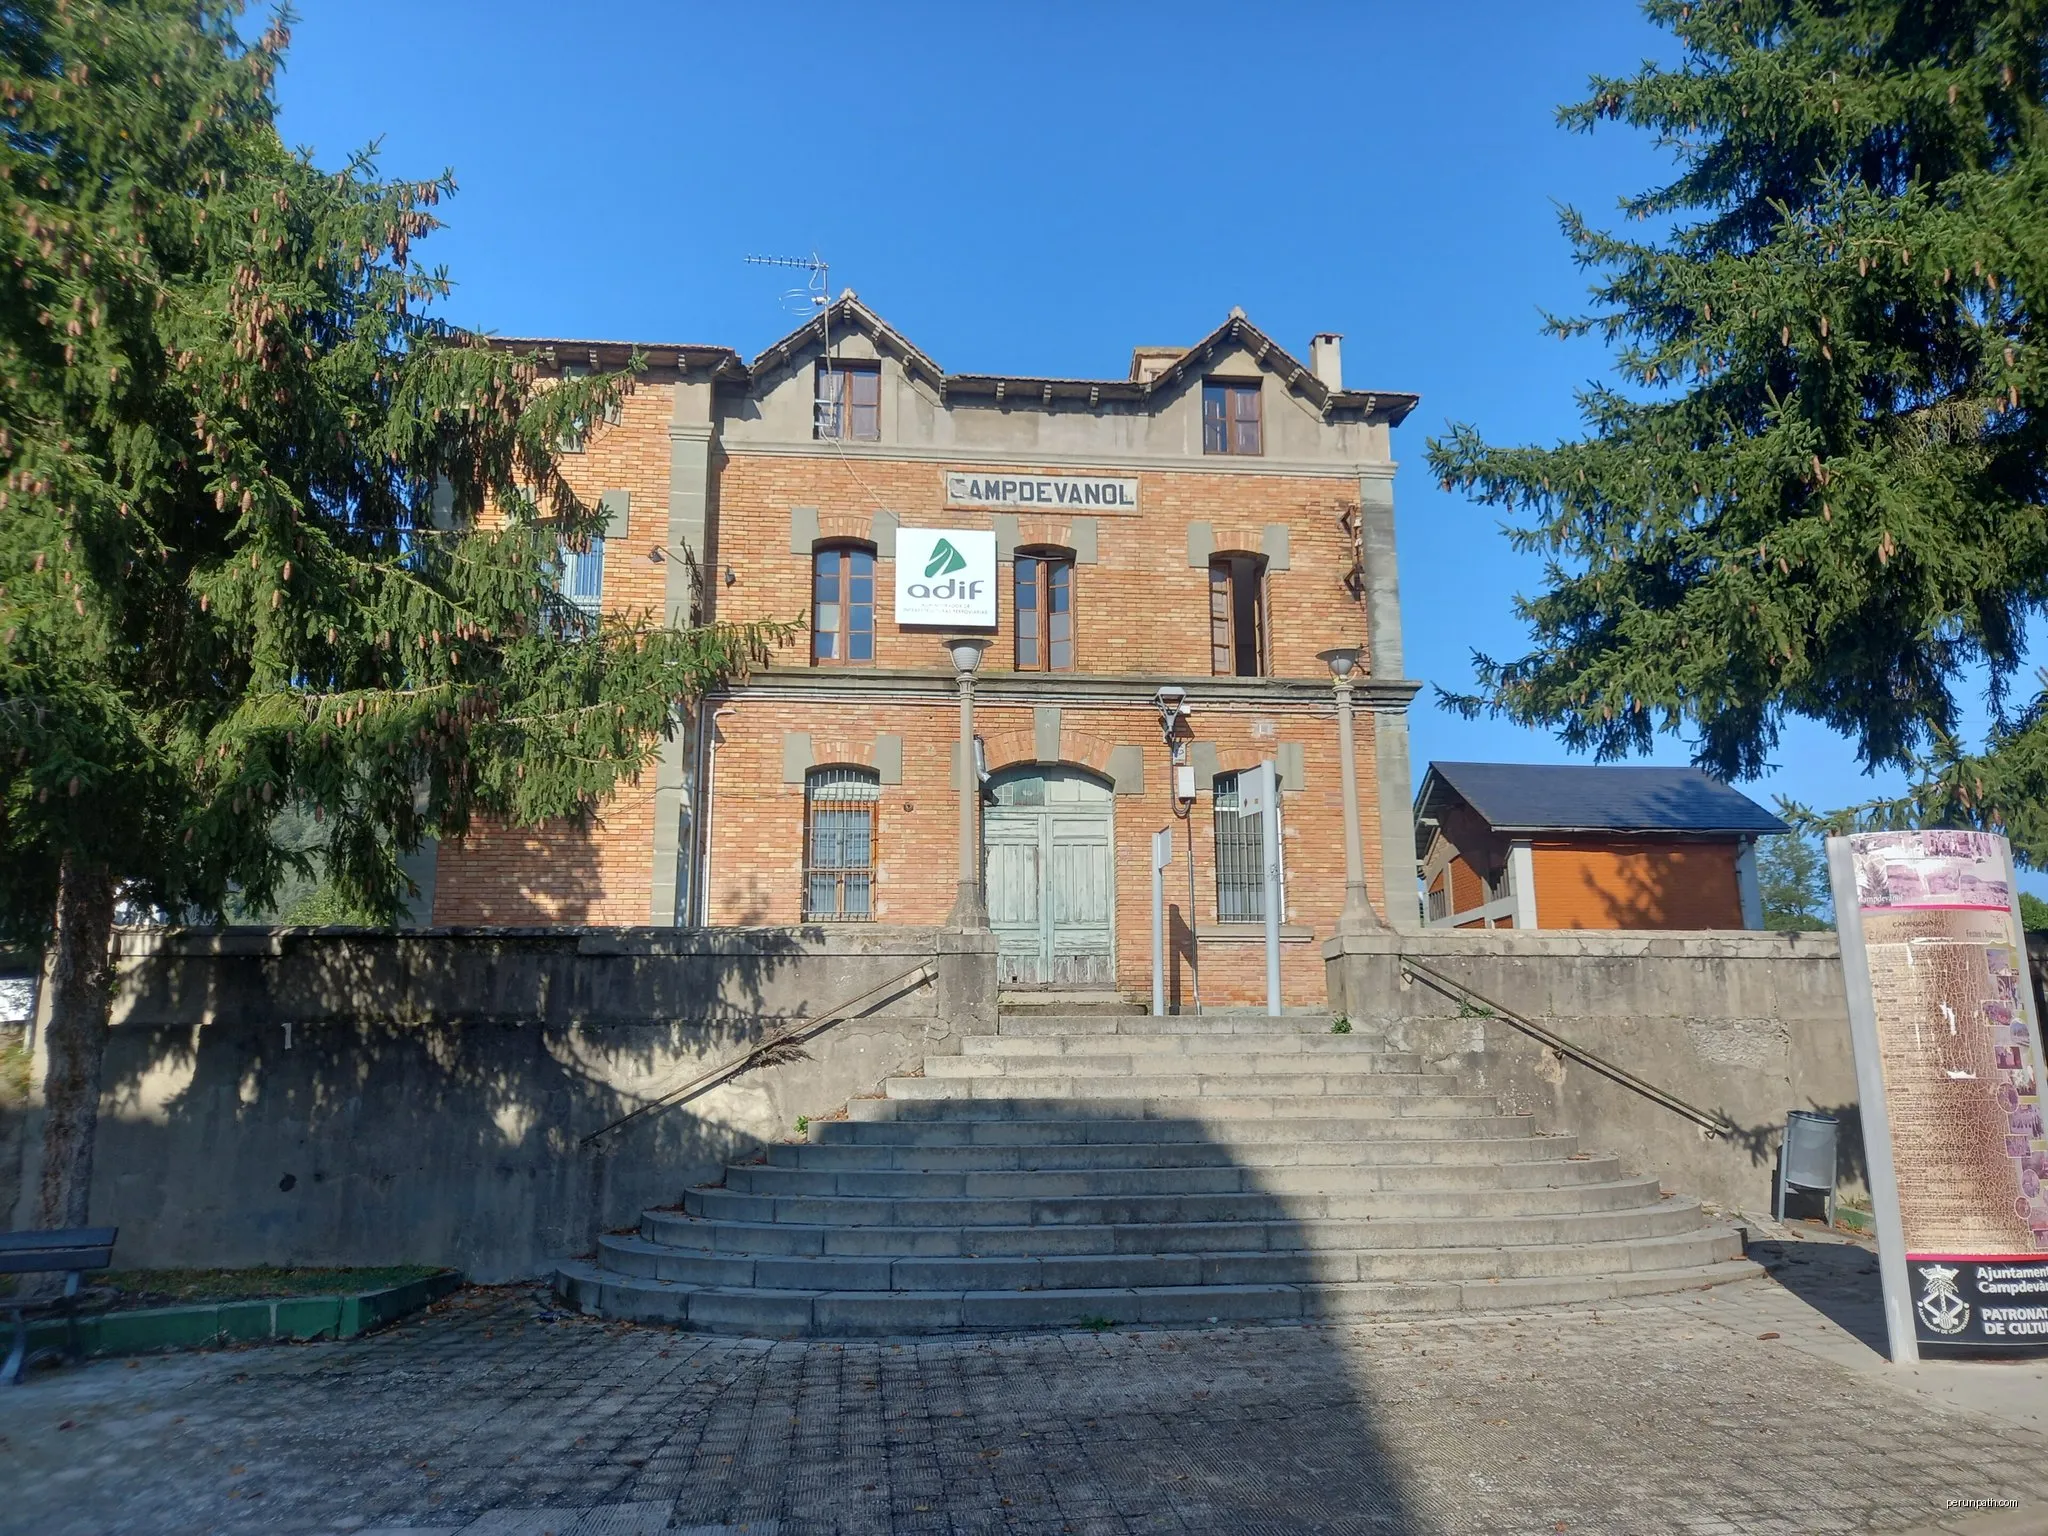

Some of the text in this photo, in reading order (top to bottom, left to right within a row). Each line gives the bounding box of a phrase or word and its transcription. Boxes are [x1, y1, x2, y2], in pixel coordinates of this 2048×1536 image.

[907, 578, 985, 600] adif
[1978, 1279, 2048, 1296] Campdevà
[1981, 1307, 2048, 1321] PATRONAT
[1985, 1321, 2048, 1335] DE CULTU
